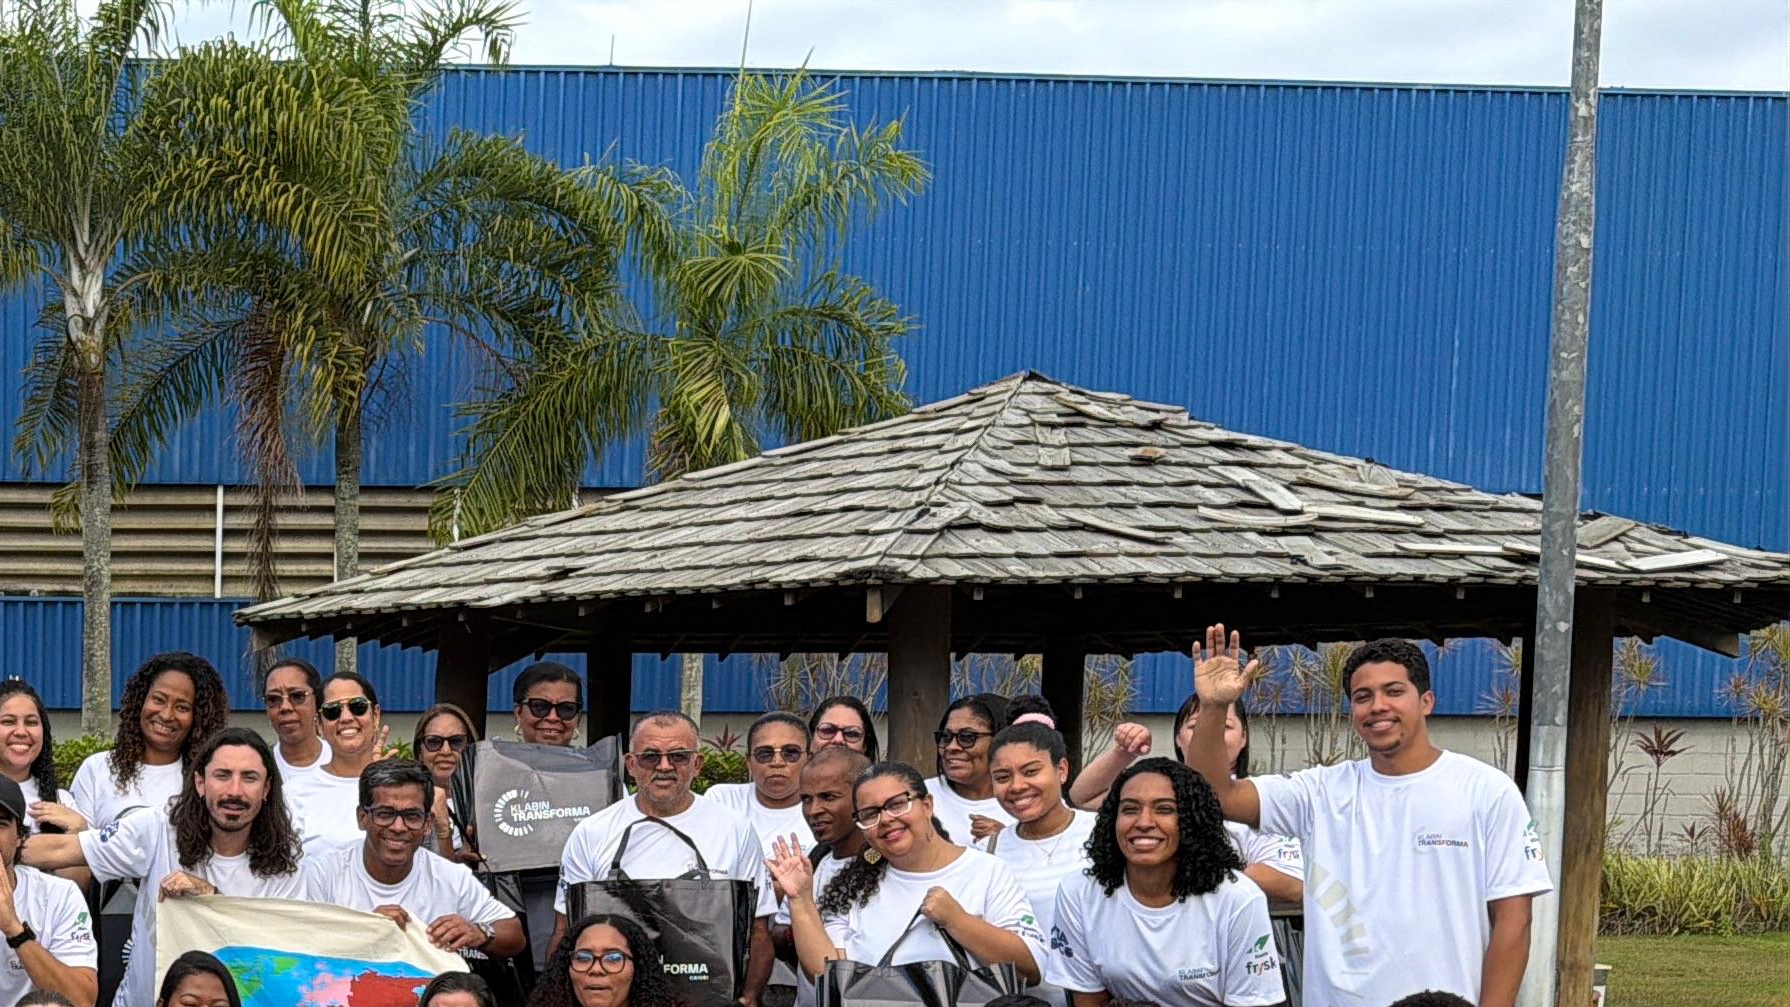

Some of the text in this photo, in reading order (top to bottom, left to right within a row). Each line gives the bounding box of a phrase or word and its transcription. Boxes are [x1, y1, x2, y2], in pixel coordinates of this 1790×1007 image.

[510, 801, 550, 813] KLABIN
[513, 806, 590, 823] TRANSFORMA
[1418, 839, 1469, 848] TRANSFORMA
[663, 963, 709, 975] FORMA
[1246, 956, 1277, 976] frysk
